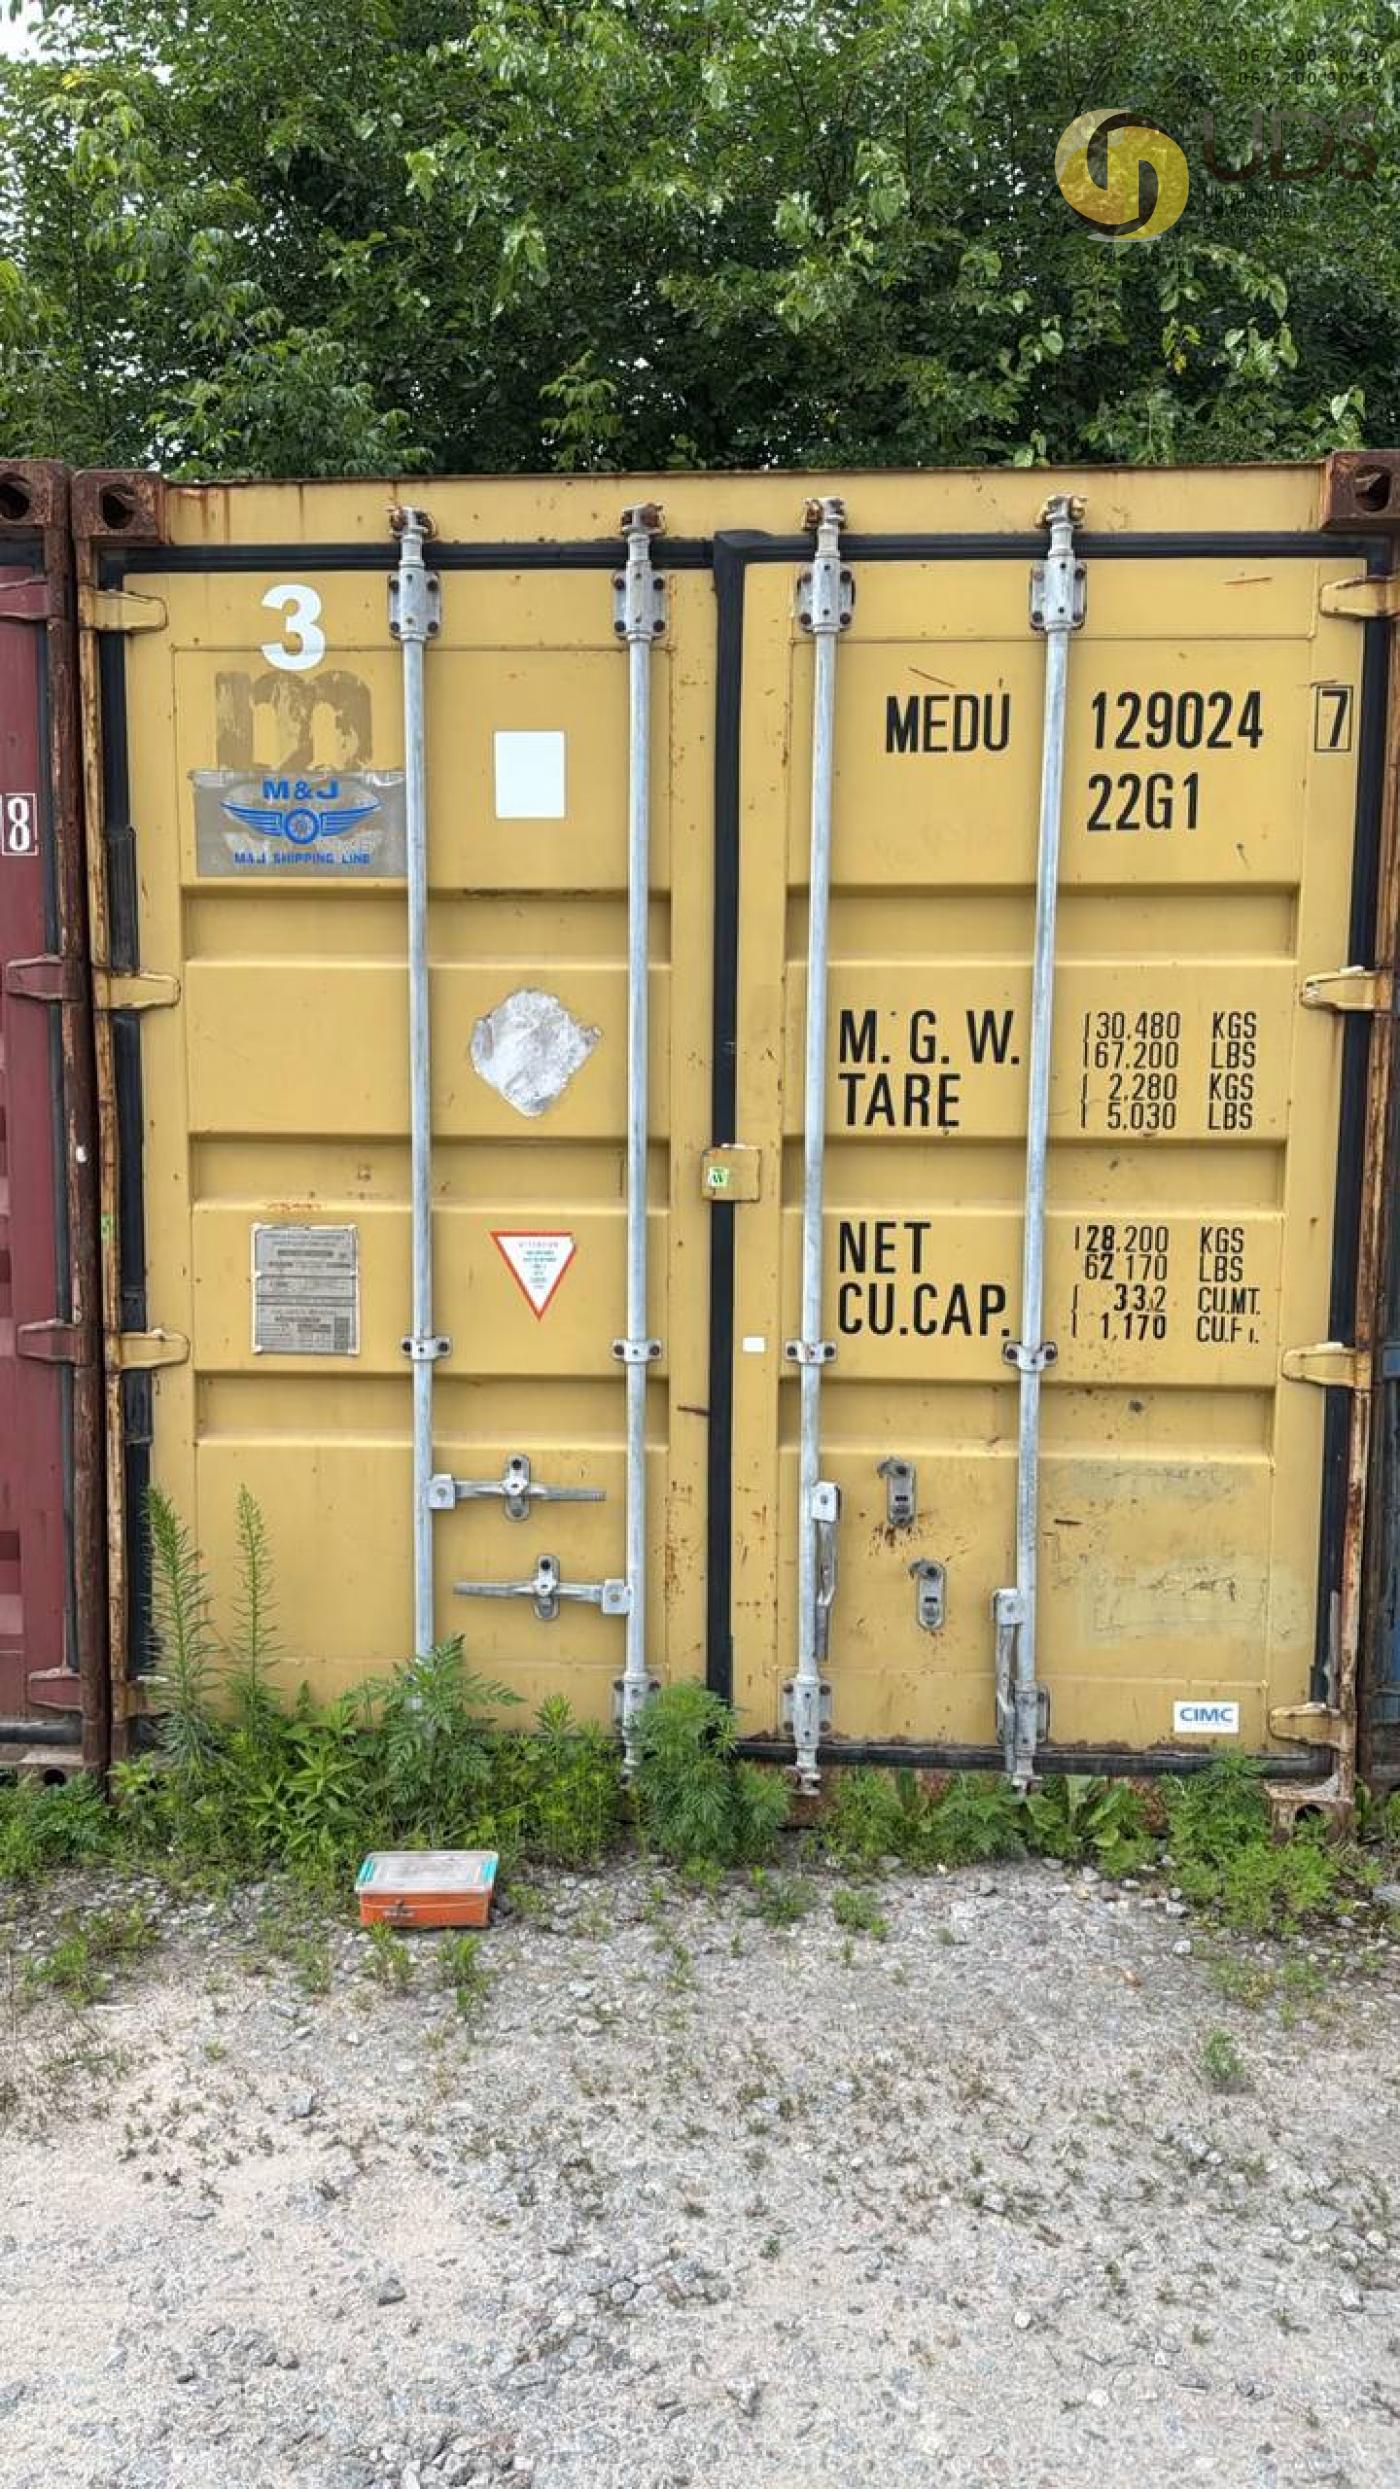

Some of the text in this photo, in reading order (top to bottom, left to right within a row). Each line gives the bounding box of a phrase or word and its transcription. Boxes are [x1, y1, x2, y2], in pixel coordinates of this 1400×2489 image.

[261, 584, 326, 671] 3
[886, 690, 1348, 753] MEDU 129024 7
[262, 778, 339, 800] M&J
[1087, 772, 1199, 831] 22G1
[8, 797, 29, 851] 8
[274, 852, 334, 865] SHIPPING
[342, 852, 370, 865] LINE
[839, 1009, 1020, 1064] M. G. W.
[1096, 1012, 1257, 1040] 30.480 KGS
[1095, 1041, 1256, 1069] 67.200 LBS
[838, 1073, 961, 1127] TARE
[1109, 1073, 1253, 1101] 2.280 KGS
[1107, 1102, 1253, 1130] 5.030 LBS
[839, 1221, 931, 1274] NET
[1200, 1227, 1245, 1254] KGS
[1199, 1255, 1244, 1282] LBS
[838, 1282, 1010, 1337] CU.CAP.
[1197, 1287, 1260, 1315] CU.MT.
[1180, 1707, 1234, 1723] CIMC
